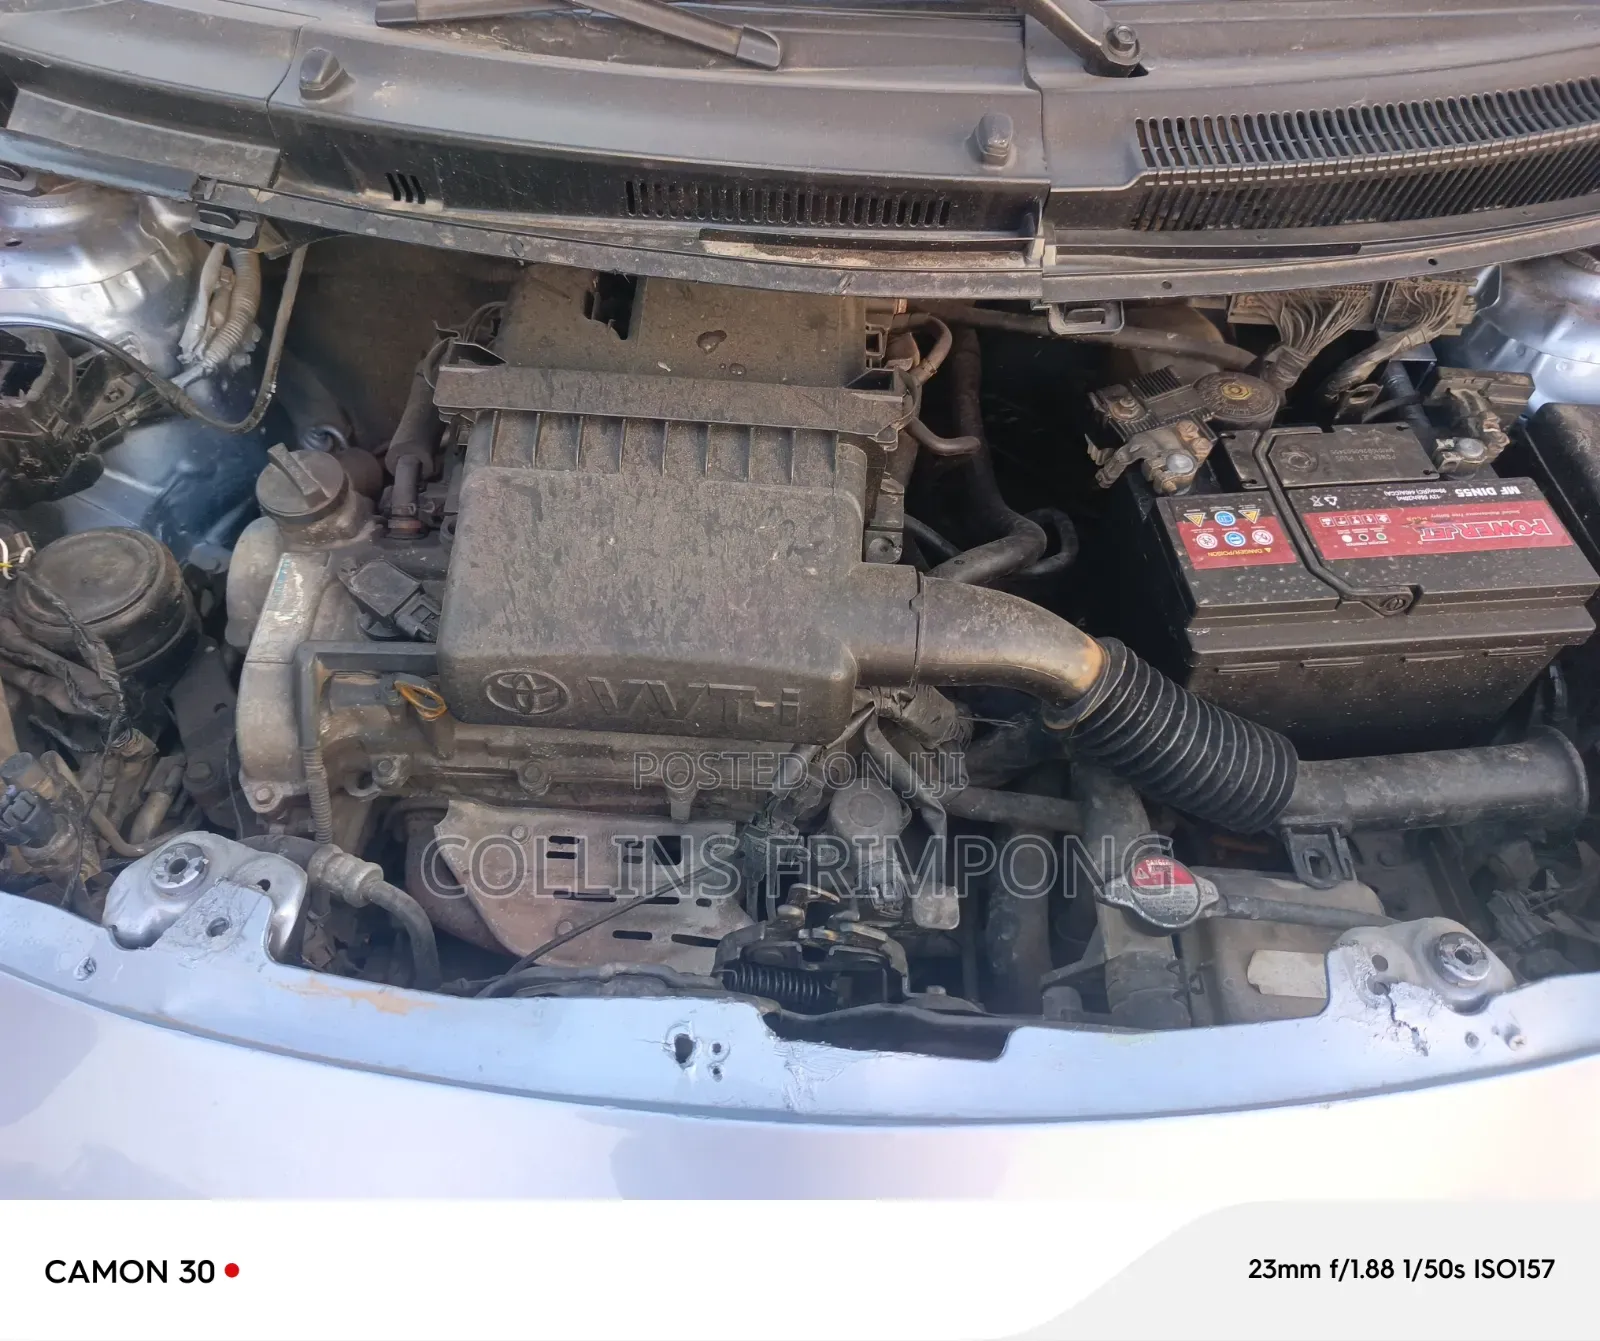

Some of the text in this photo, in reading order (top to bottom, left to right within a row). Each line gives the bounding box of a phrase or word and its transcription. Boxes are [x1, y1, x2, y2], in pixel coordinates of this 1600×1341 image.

[1454, 486, 1521, 497] MF DIN55
[1419, 518, 1552, 541] POWER JET
[1207, 547, 1262, 556] DANGER/POISON
